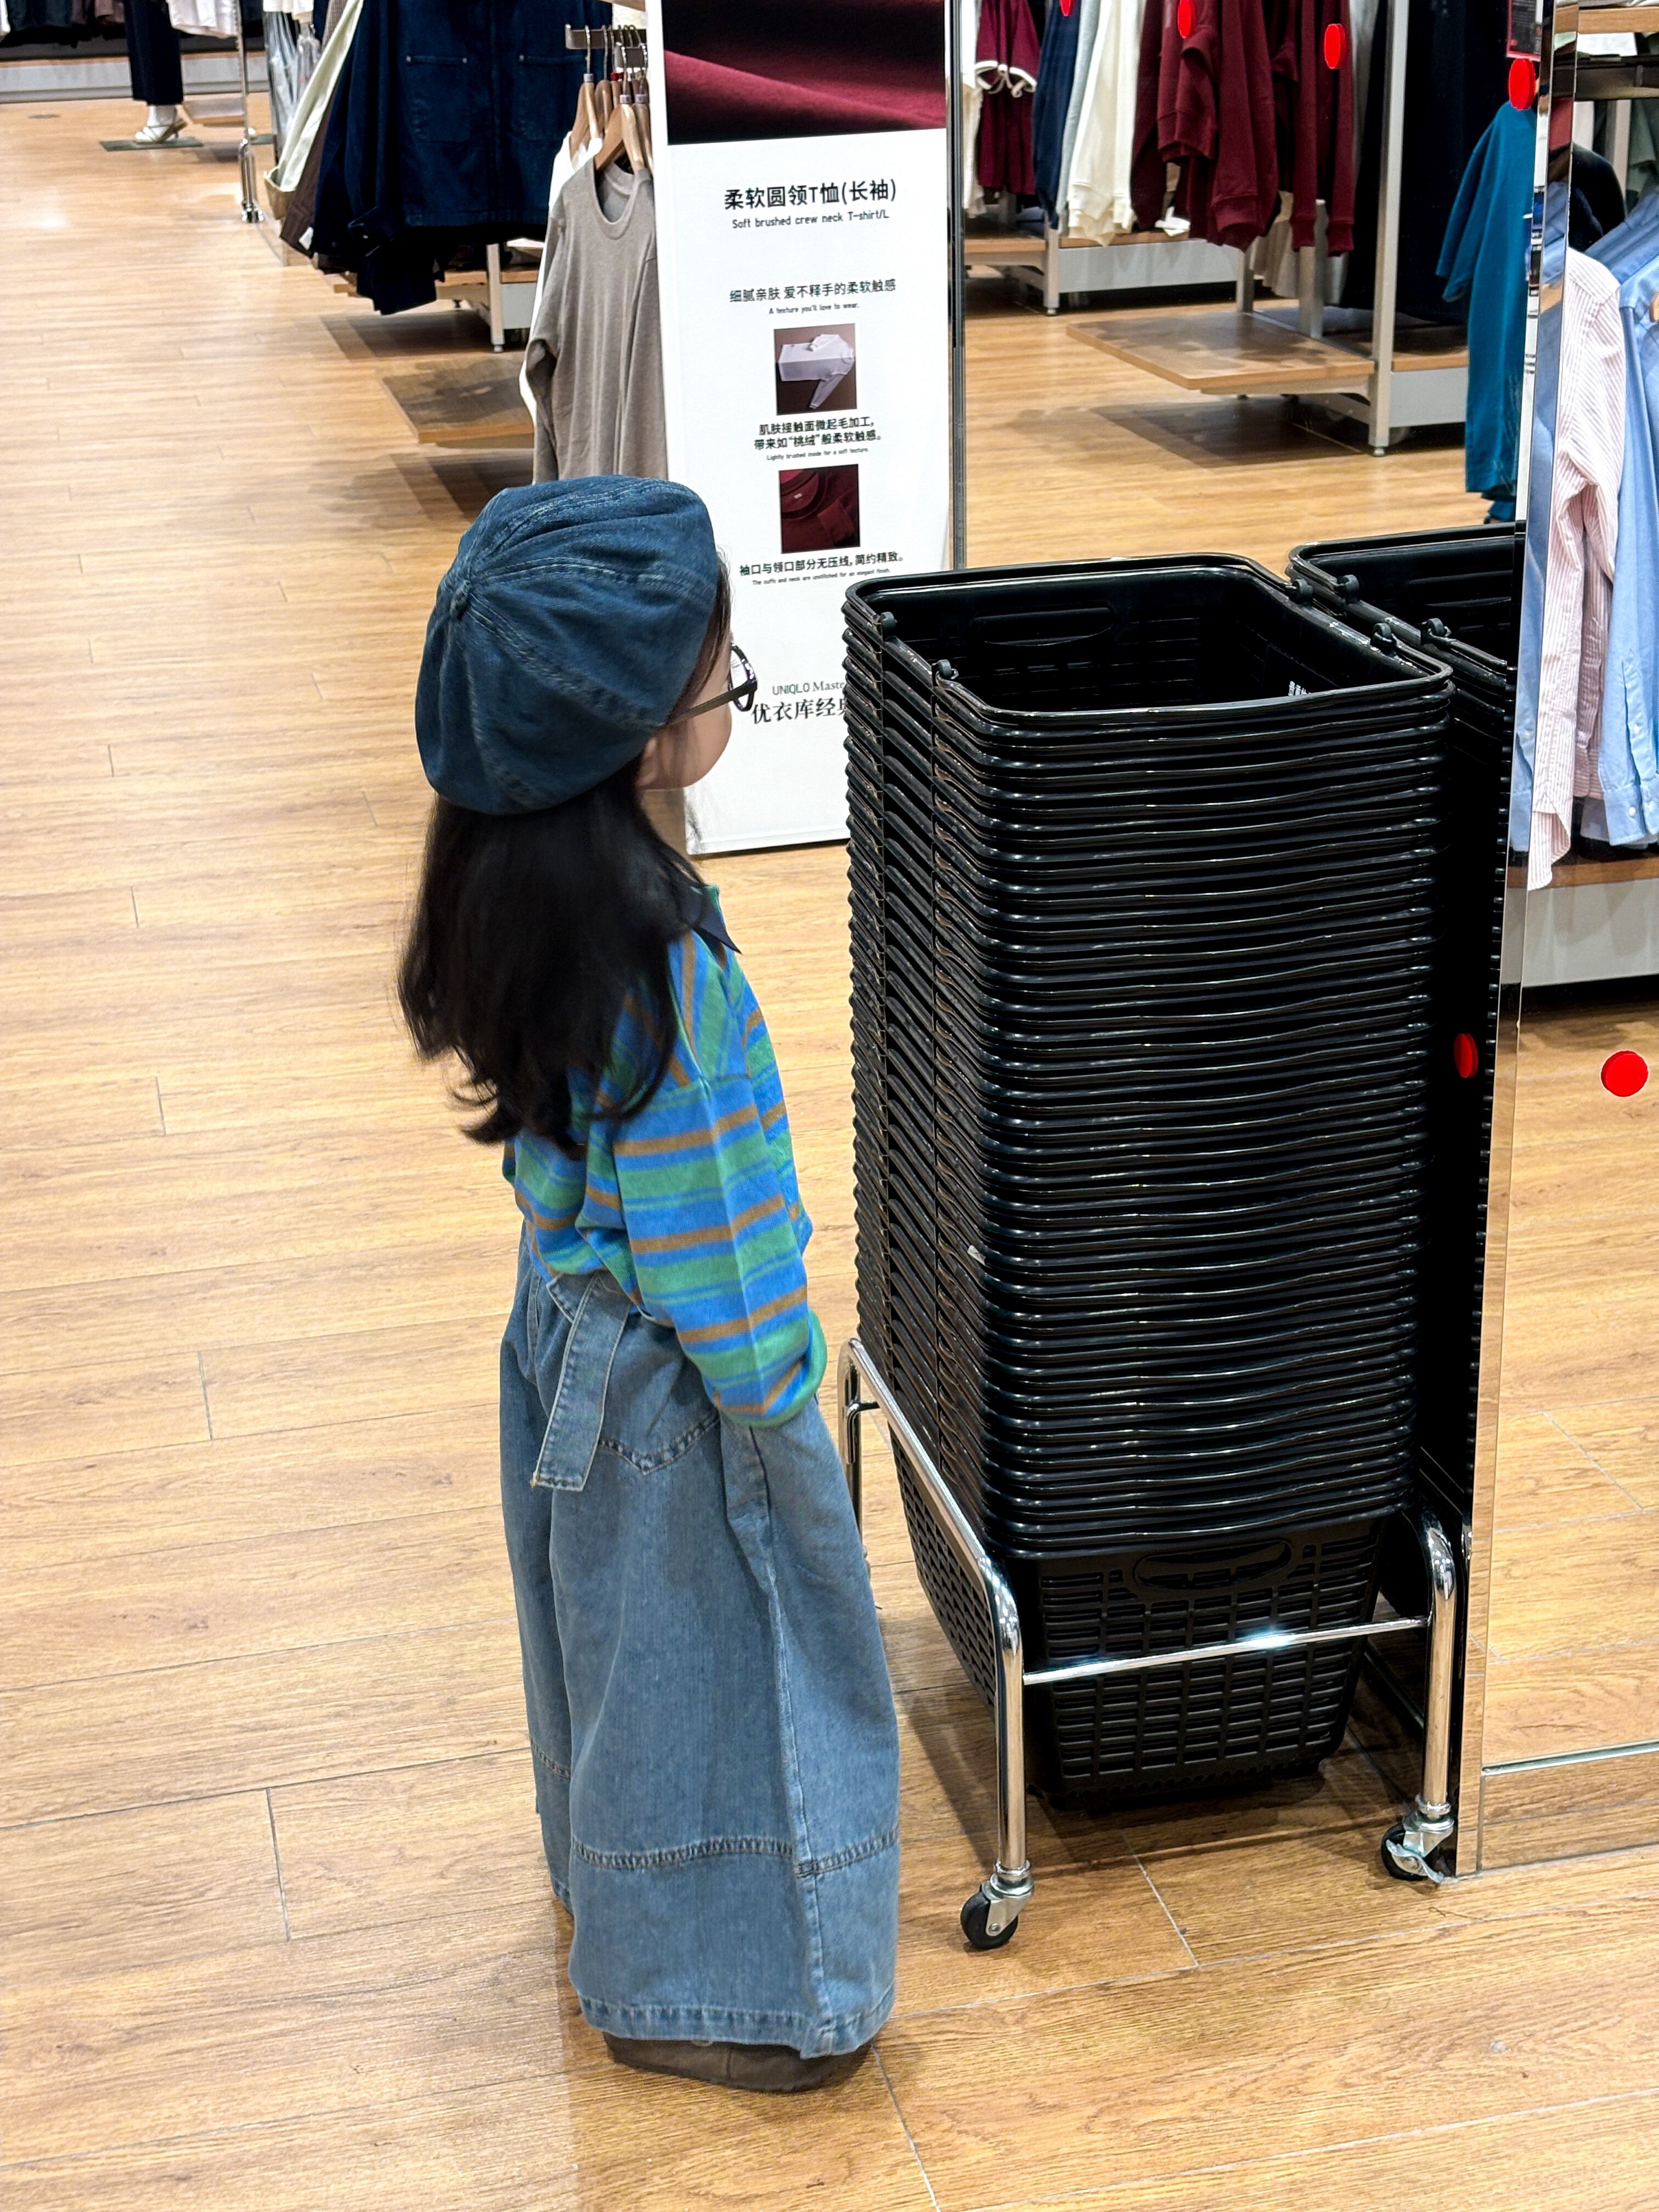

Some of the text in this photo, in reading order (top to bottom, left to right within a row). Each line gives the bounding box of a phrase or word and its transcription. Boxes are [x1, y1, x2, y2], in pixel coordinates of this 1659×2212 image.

[724, 178, 896, 211] 柔软圆领T恤(长袖)
[732, 218, 751, 229] Soft
[755, 216, 791, 227] brushed
[822, 212, 843, 223] neck
[848, 210, 889, 221] T-shirt/L
[730, 279, 896, 302] 细腻亲肤 爱不释手的柔软触感
[772, 683, 810, 695] UNIQLO
